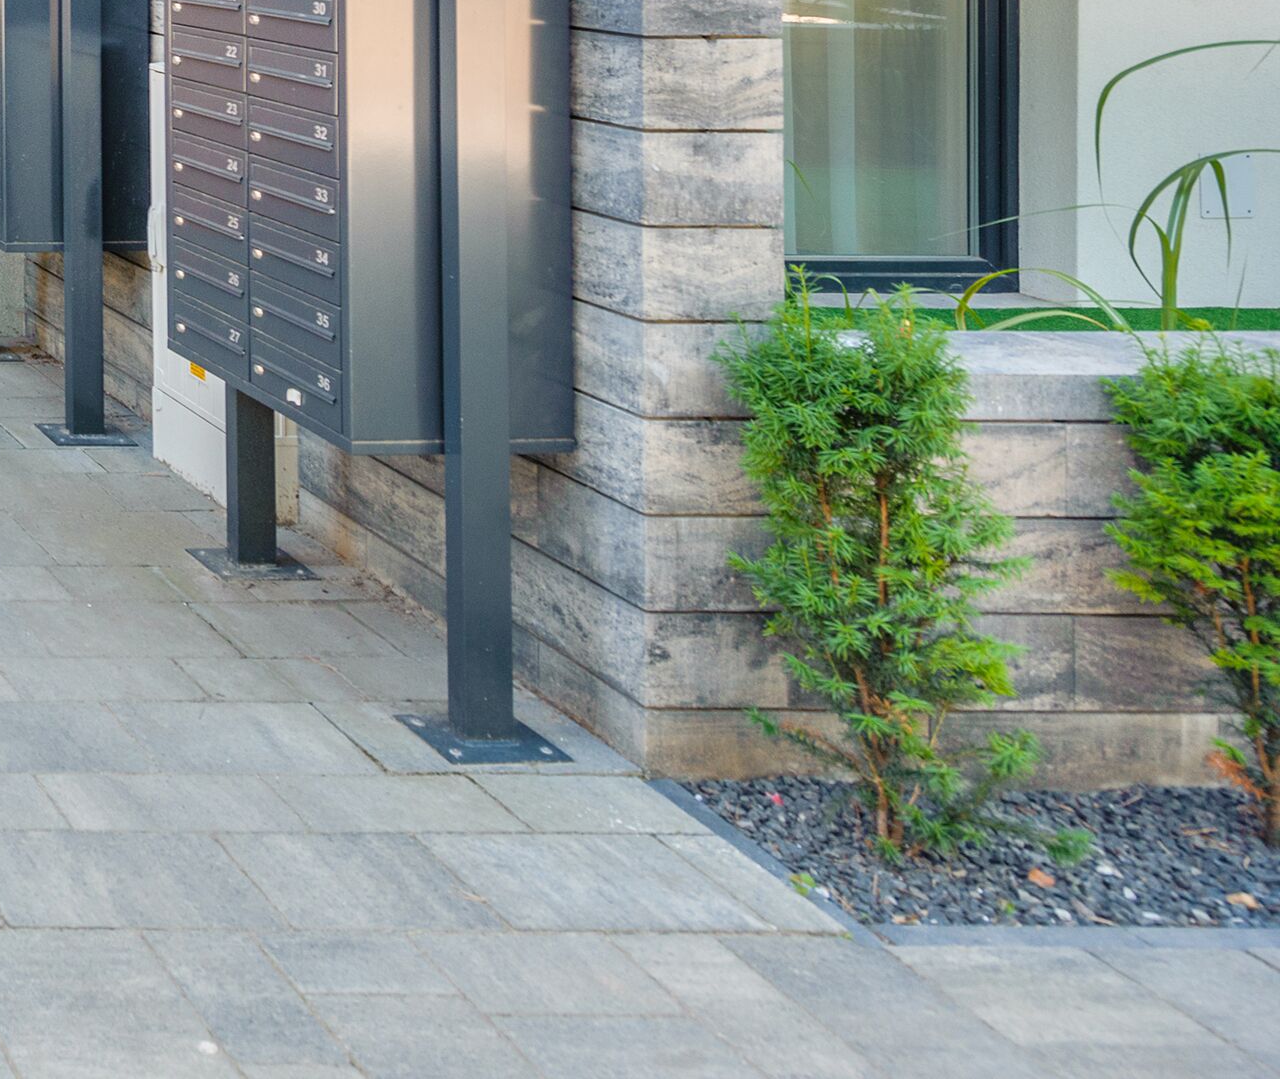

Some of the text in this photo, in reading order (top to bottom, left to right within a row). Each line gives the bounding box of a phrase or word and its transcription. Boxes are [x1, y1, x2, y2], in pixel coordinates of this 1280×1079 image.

[312, 1, 326, 16] 30
[225, 45, 238, 58] 22
[314, 63, 327, 78] 31
[226, 102, 238, 115] 23
[313, 125, 328, 141] 32
[227, 159, 238, 172] 24
[314, 187, 329, 203] 33
[227, 215, 239, 229] 25
[315, 250, 329, 266] 34
[228, 272, 240, 287] 26
[316, 312, 330, 329] 35
[229, 329, 240, 344] 27
[316, 374, 331, 392] 36
